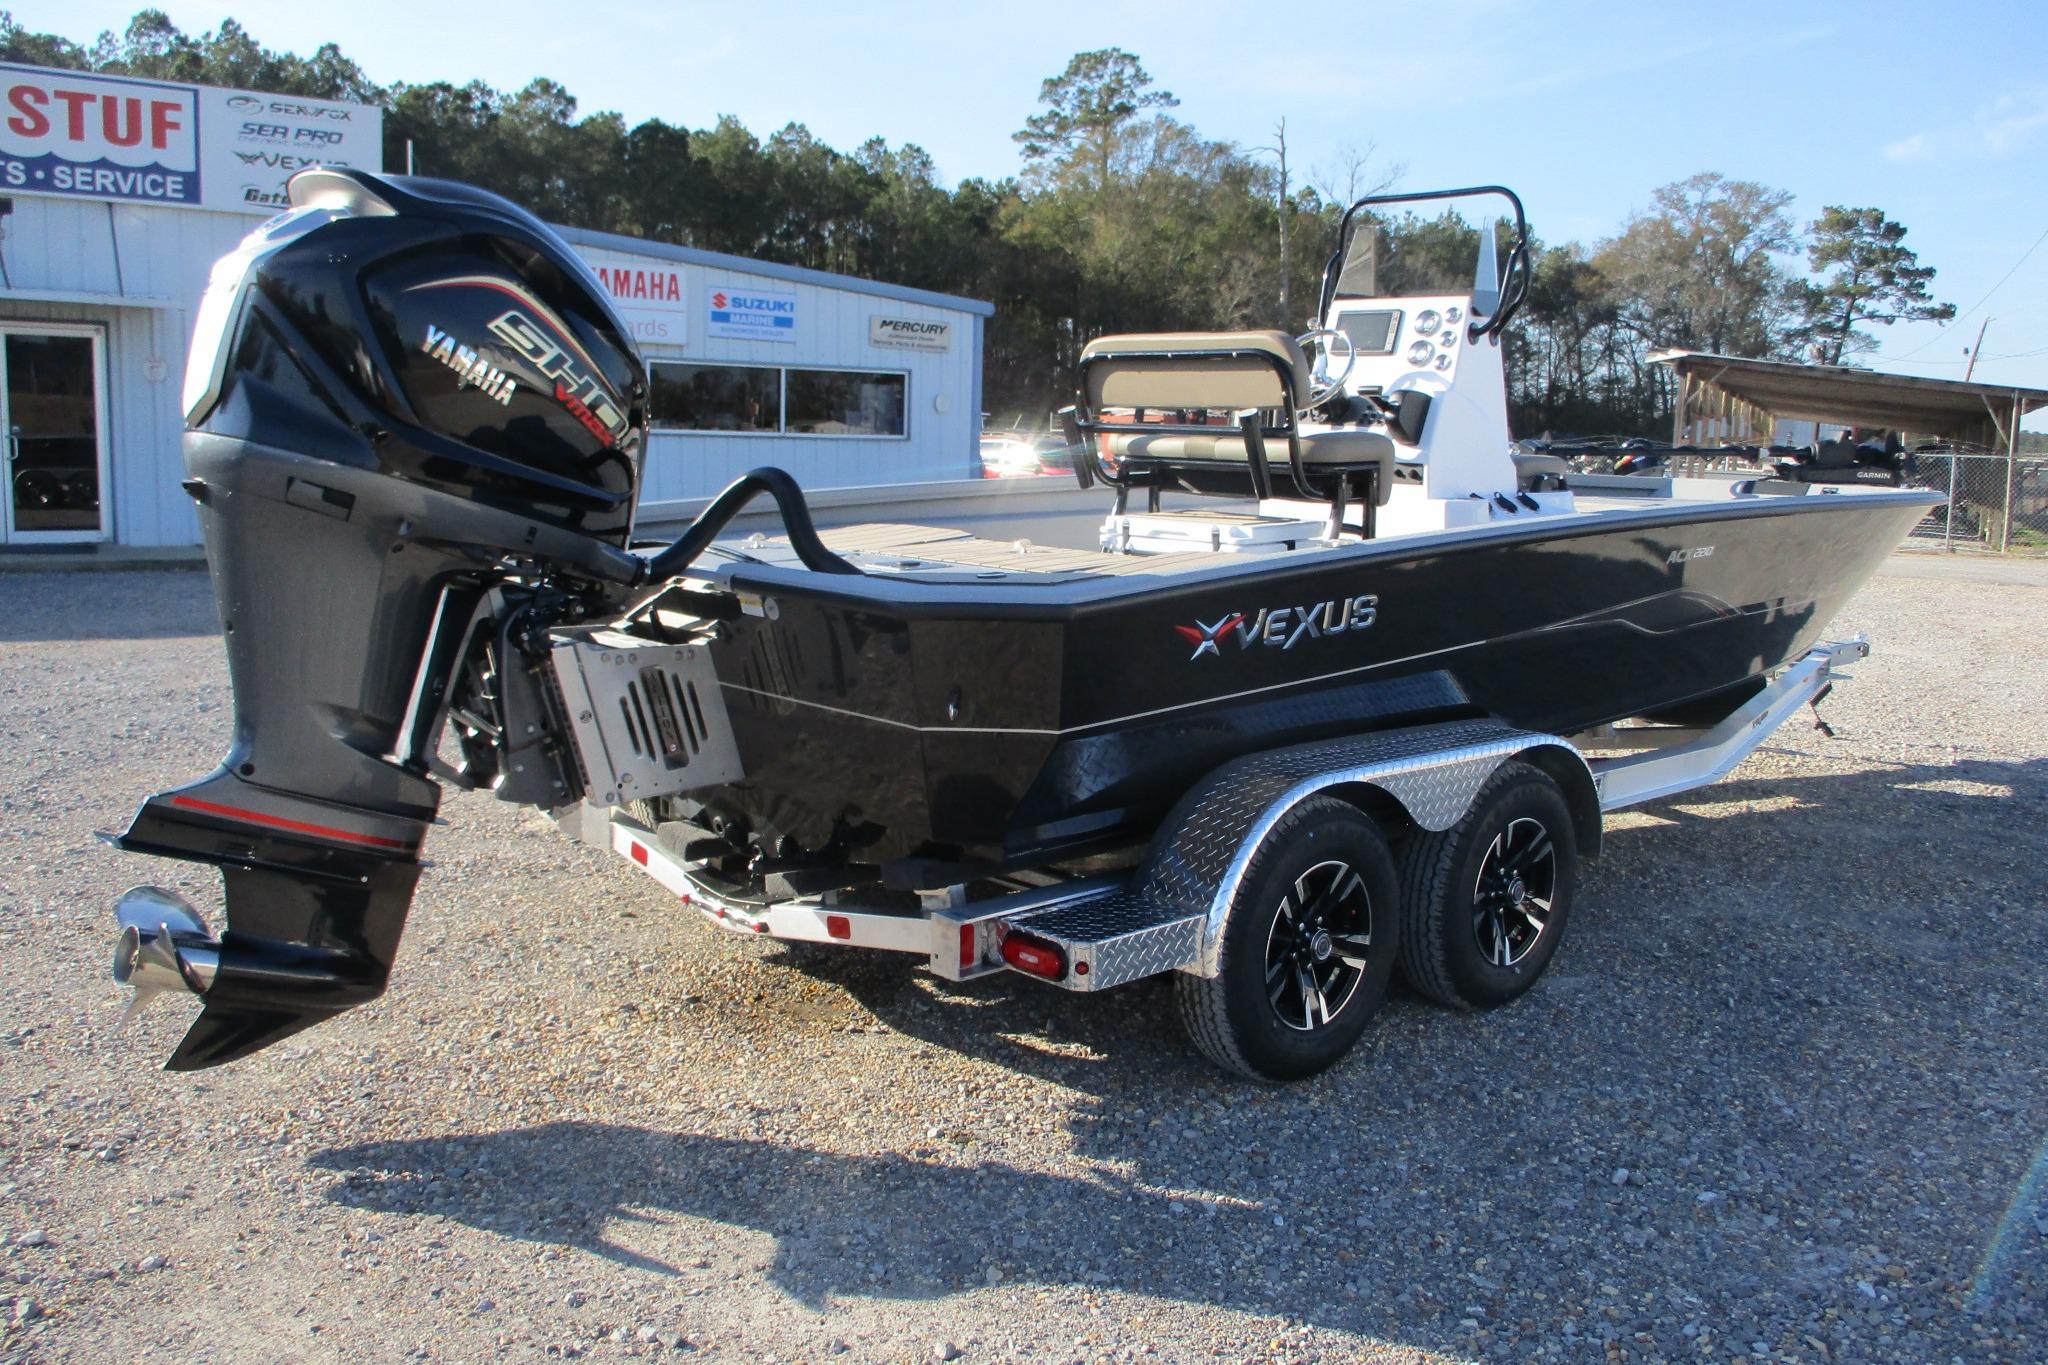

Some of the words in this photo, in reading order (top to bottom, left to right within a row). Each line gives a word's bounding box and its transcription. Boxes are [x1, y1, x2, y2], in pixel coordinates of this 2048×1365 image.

[8, 85, 182, 149] STUF
[240, 122, 289, 139] SEA
[295, 128, 343, 145] PRO
[261, 152, 350, 171] VEX
[53, 165, 184, 198] SERVICE
[593, 267, 680, 302] AMAHA
[731, 296, 795, 313] SUZUKI
[880, 319, 948, 335] MERCURY
[422, 324, 517, 407] YAMAHA
[1856, 471, 1892, 479] GARMIN
[1231, 594, 1379, 651] VEXUS
